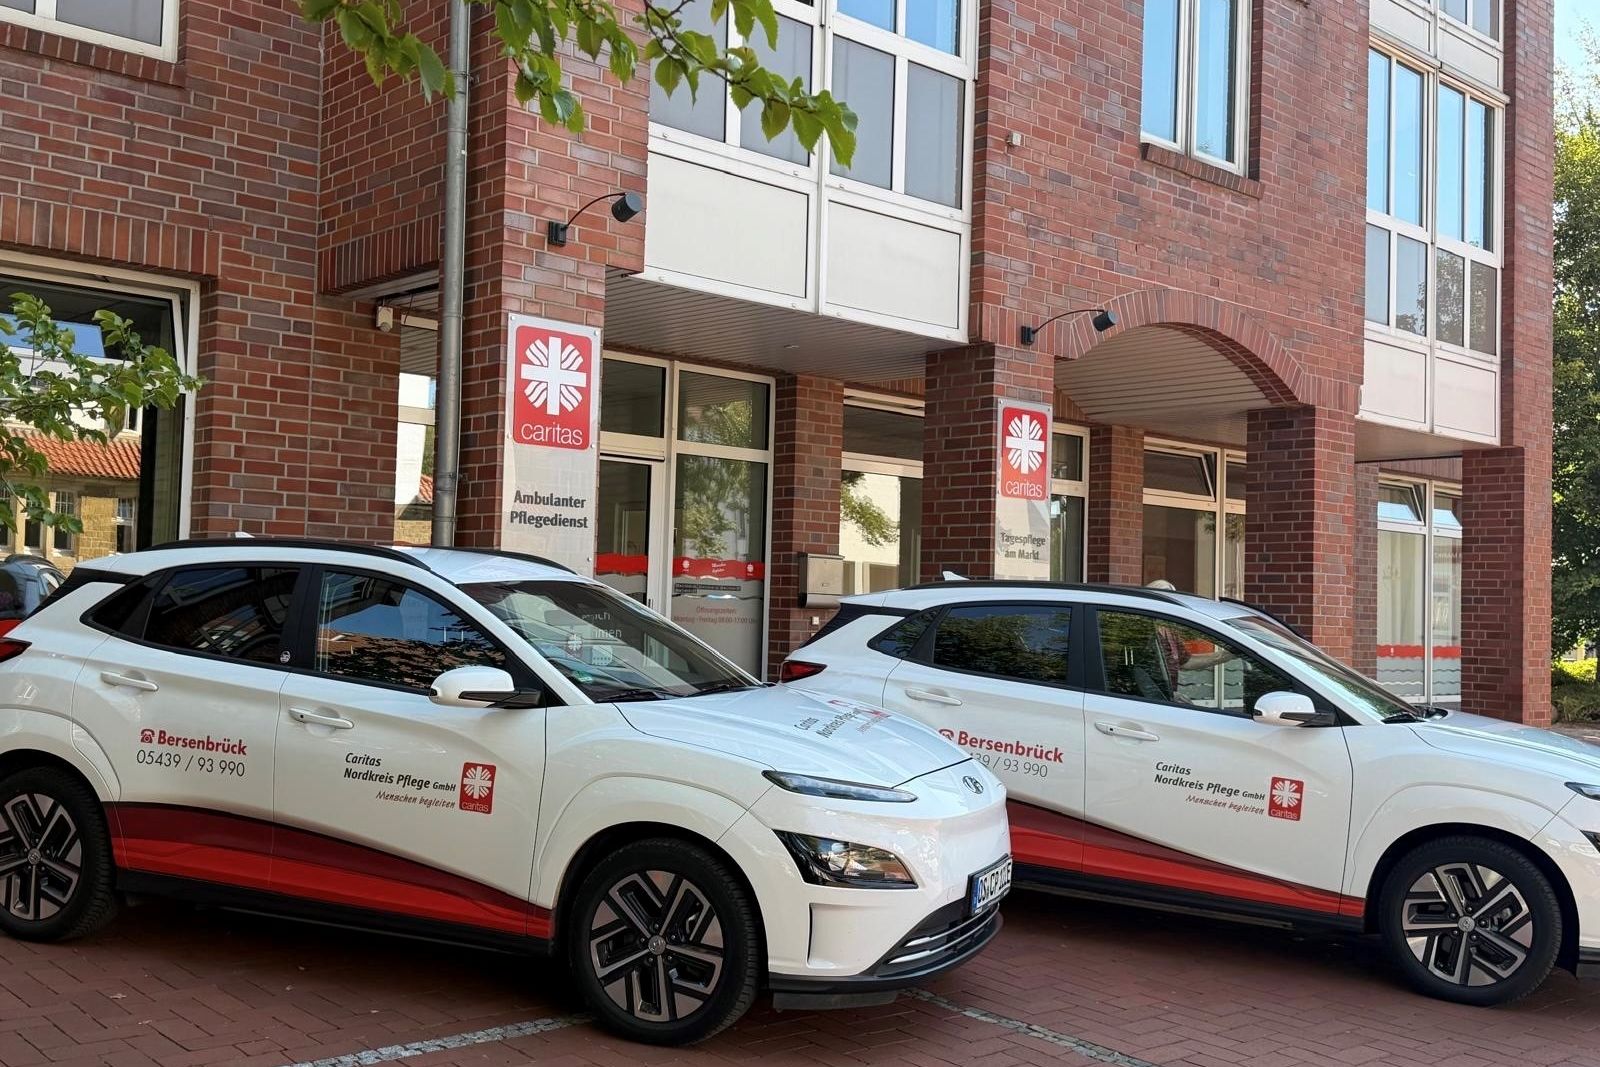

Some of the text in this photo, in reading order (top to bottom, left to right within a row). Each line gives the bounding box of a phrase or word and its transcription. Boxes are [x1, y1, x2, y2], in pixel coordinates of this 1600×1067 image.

[521, 421, 583, 445] caritas
[1005, 480, 1042, 497] caritas
[513, 489, 587, 509] Ambulanter
[510, 510, 588, 529] Pflegedienst
[1000, 532, 1046, 548] Tagespflege
[1004, 549, 1040, 560] am Markt
[157, 729, 248, 756] Bersenbrück
[957, 730, 1064, 764] Bersenbrück
[136, 749, 246, 777] 05439 / 93 990
[345, 752, 382, 767] Caritas
[1003, 758, 1019, 773] 93
[1023, 761, 1048, 778] 990
[1155, 761, 1192, 776] Caritas
[343, 767, 457, 792] Nordkreis Pflege GmbH
[1154, 773, 1266, 801] Nordkreis Pflege GmbH
[375, 790, 456, 809] Menschen begleiten
[461, 801, 489, 812] caritas
[1185, 795, 1265, 815] Menschen begleiten
[1270, 808, 1298, 820] caritas
